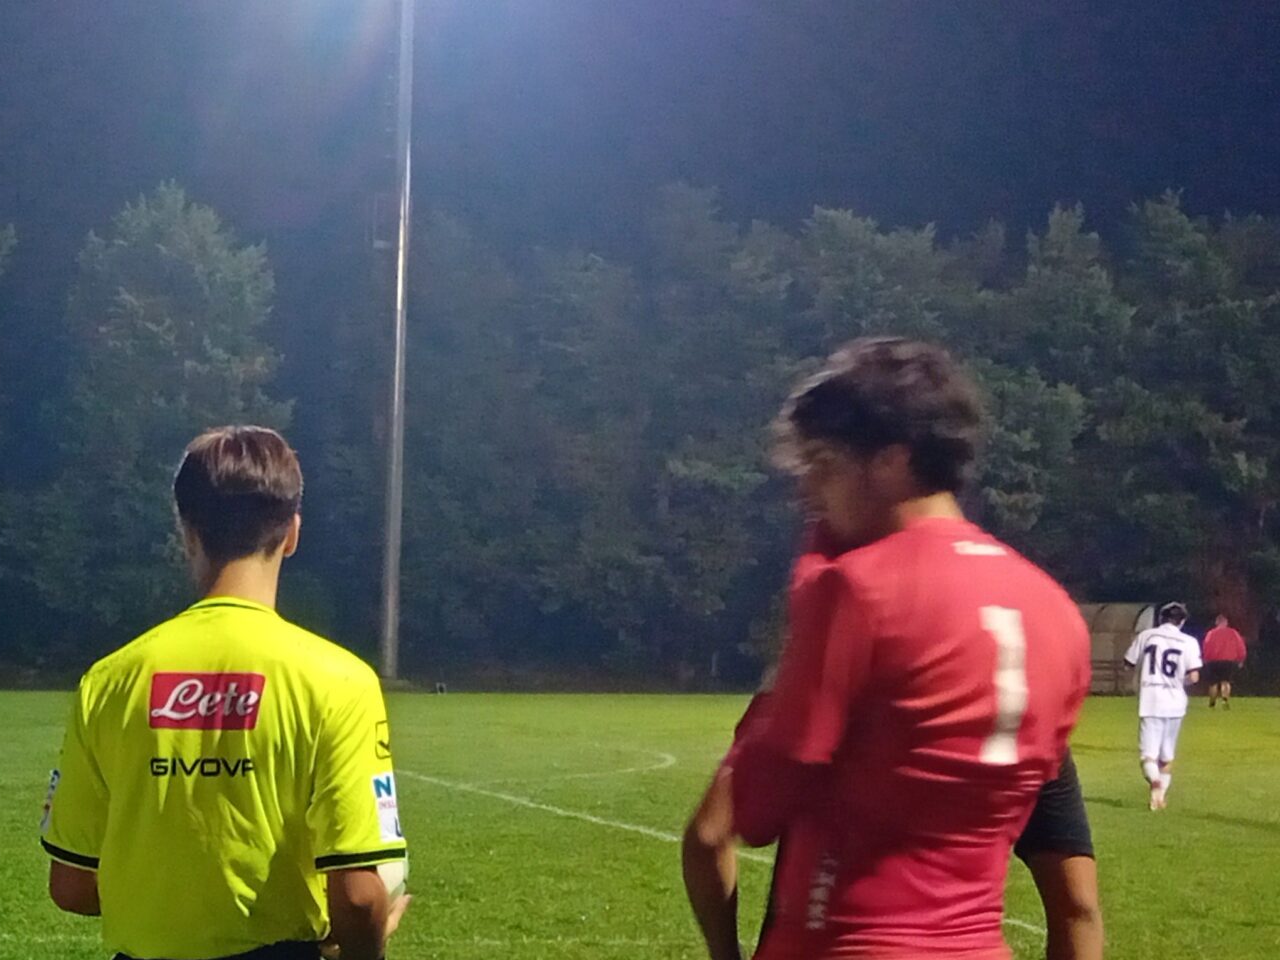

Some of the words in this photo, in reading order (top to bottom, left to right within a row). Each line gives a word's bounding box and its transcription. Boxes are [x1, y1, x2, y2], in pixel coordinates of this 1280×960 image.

[1143, 644, 1182, 678] 16
[151, 678, 259, 720] Lete
[978, 604, 1028, 766] 1
